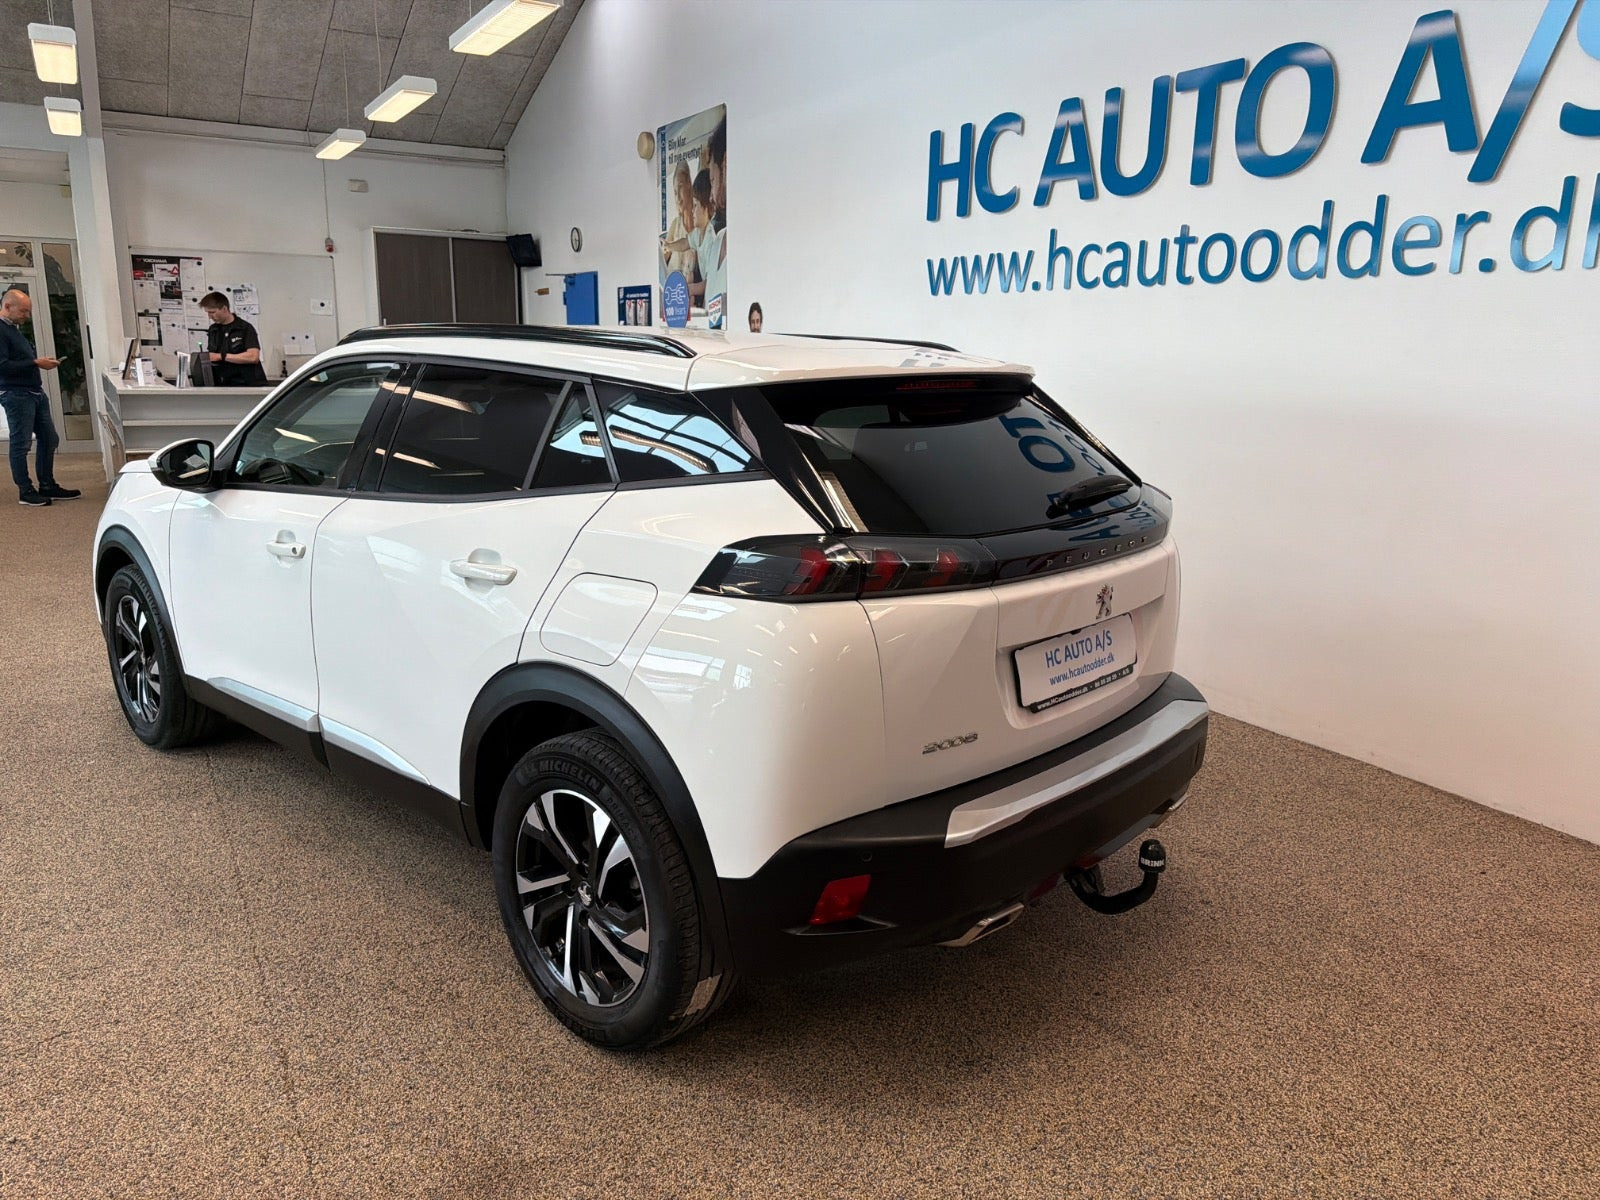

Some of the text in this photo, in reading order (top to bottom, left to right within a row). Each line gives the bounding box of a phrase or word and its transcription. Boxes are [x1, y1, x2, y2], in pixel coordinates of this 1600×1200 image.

[926, 111, 1025, 221] HC
[1033, 41, 1338, 207] AUTO
[926, 172, 1600, 297] www.hcautoodder.d
[1046, 536, 1148, 568] PEUGEOT
[1045, 629, 1113, 668] HC AUTO A/S
[1049, 652, 1115, 686] www.hcautoodder.dk
[922, 731, 979, 755] 2008
[540, 760, 601, 791] MICHELIN
[1140, 857, 1164, 867] BRINK
